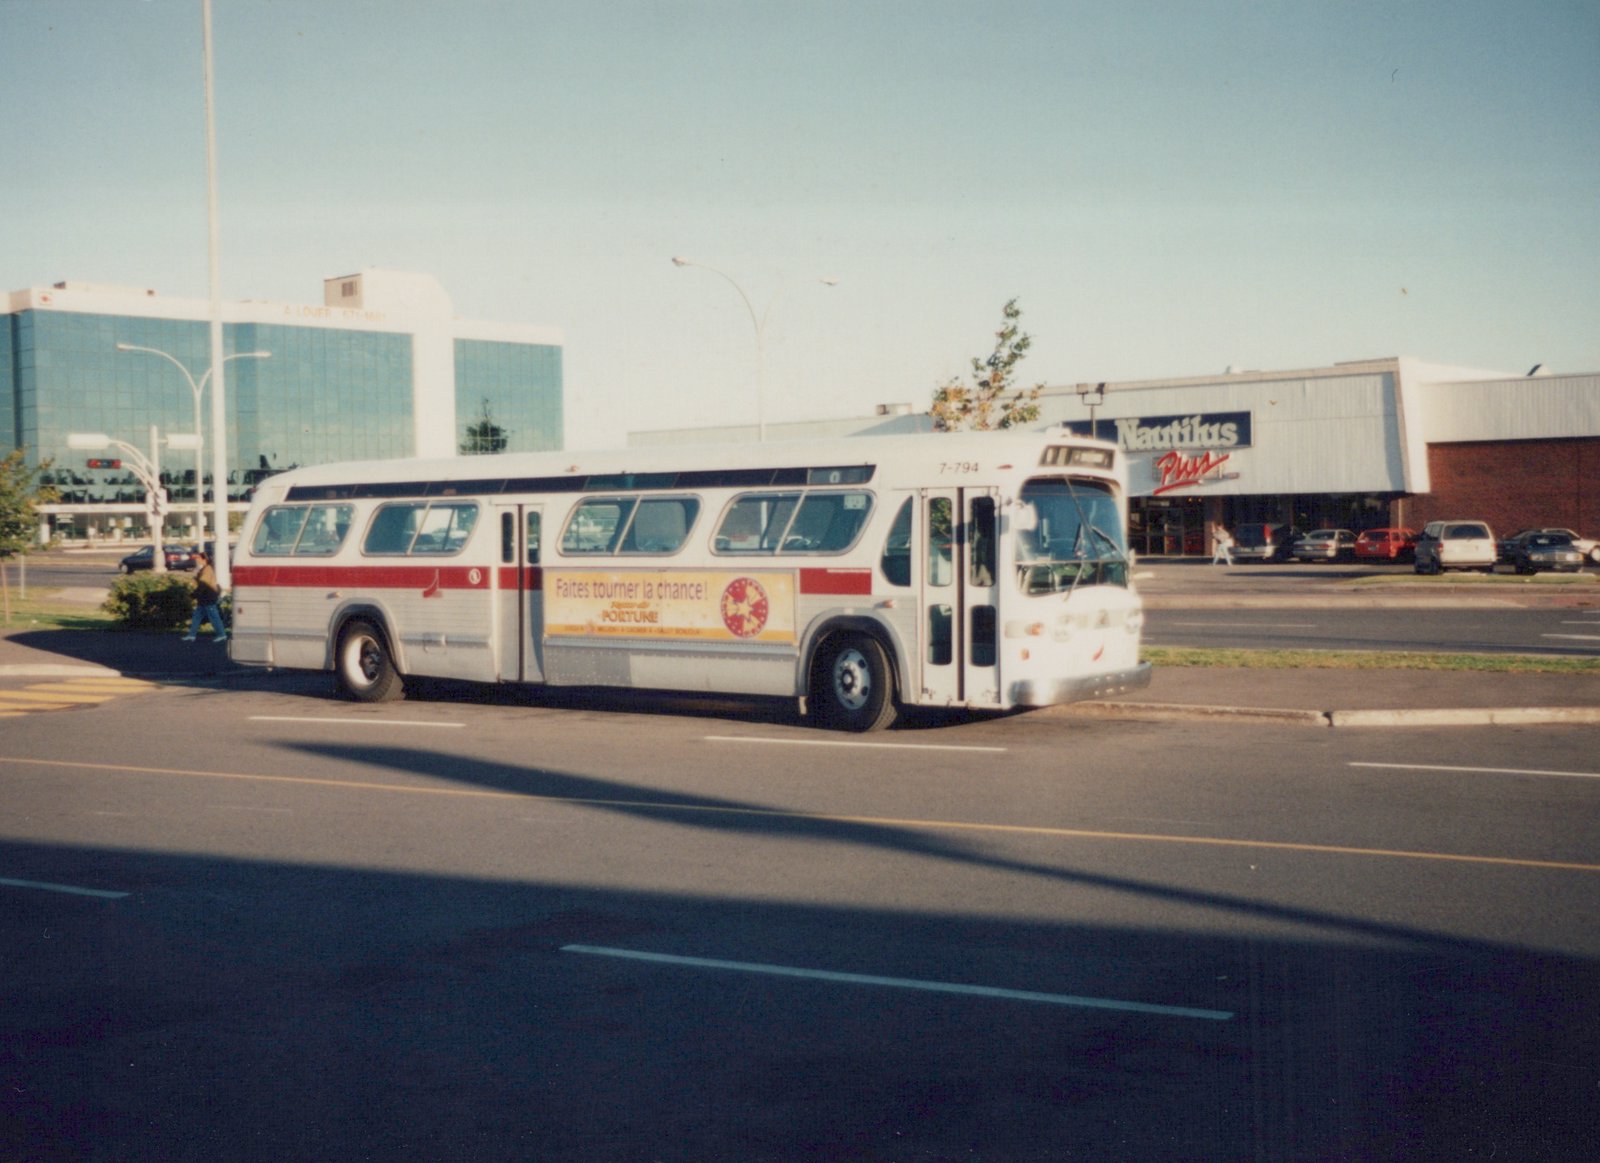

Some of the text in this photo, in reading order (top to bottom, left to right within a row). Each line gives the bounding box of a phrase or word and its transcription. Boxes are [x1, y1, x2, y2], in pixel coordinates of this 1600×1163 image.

[1114, 415, 1239, 450] Nautilus
[939, 462, 979, 474] 7-794
[1155, 451, 1230, 486] Plus
[556, 578, 590, 598] Faites
[592, 580, 639, 599] tourner
[643, 580, 653, 600] la
[602, 610, 658, 623] FORTUNE
